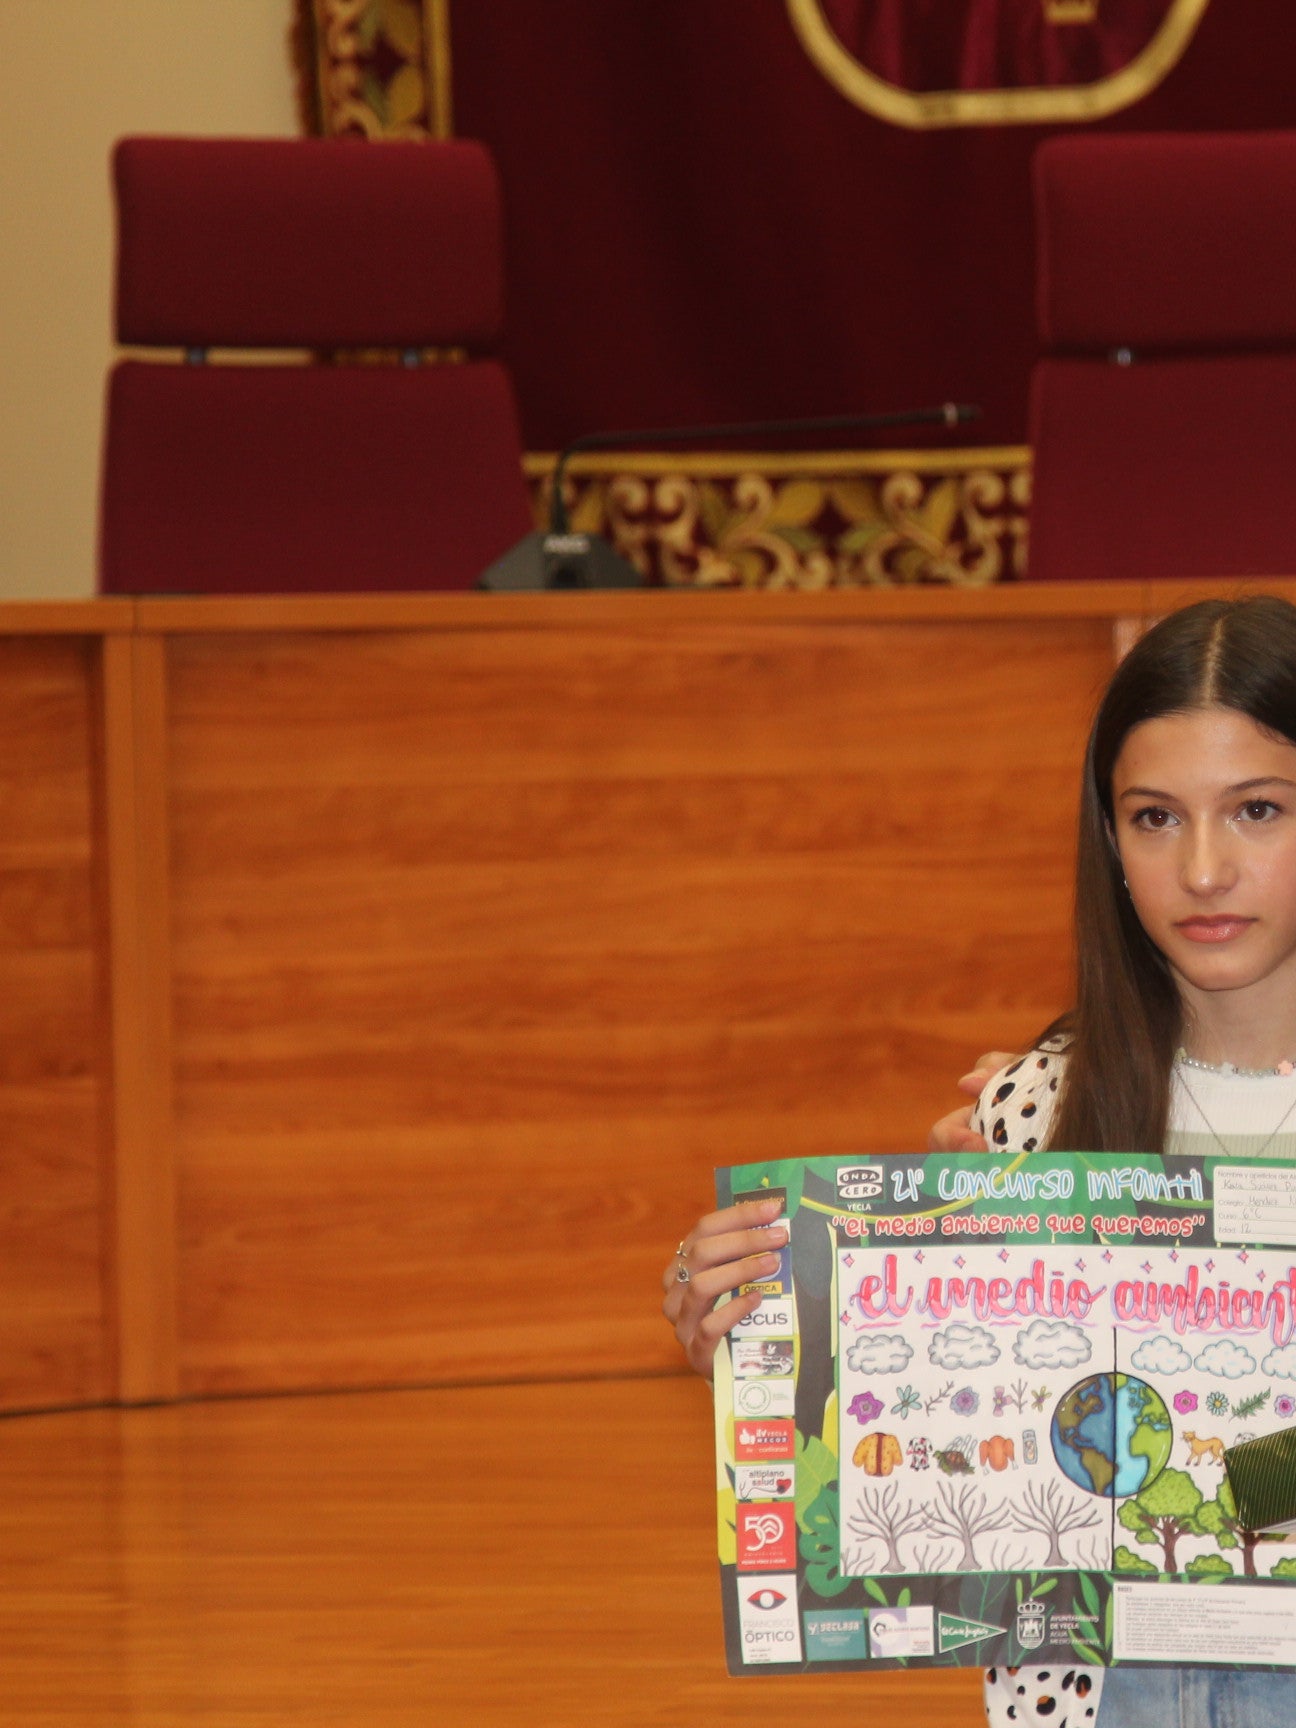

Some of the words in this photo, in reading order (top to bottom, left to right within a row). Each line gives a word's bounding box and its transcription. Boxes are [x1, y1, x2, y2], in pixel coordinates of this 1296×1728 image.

[843, 1172, 878, 1181] ONDA
[845, 1186, 877, 1195] CERO
[847, 1203, 872, 1211] YECLA
[875, 1215, 936, 1236] medio
[941, 1214, 1040, 1235] ambiente
[1046, 1214, 1085, 1234] que
[850, 1254, 914, 1319] el
[918, 1259, 1107, 1321] medio
[749, 1470, 785, 1480] altiplano
[752, 1478, 775, 1486] salud
